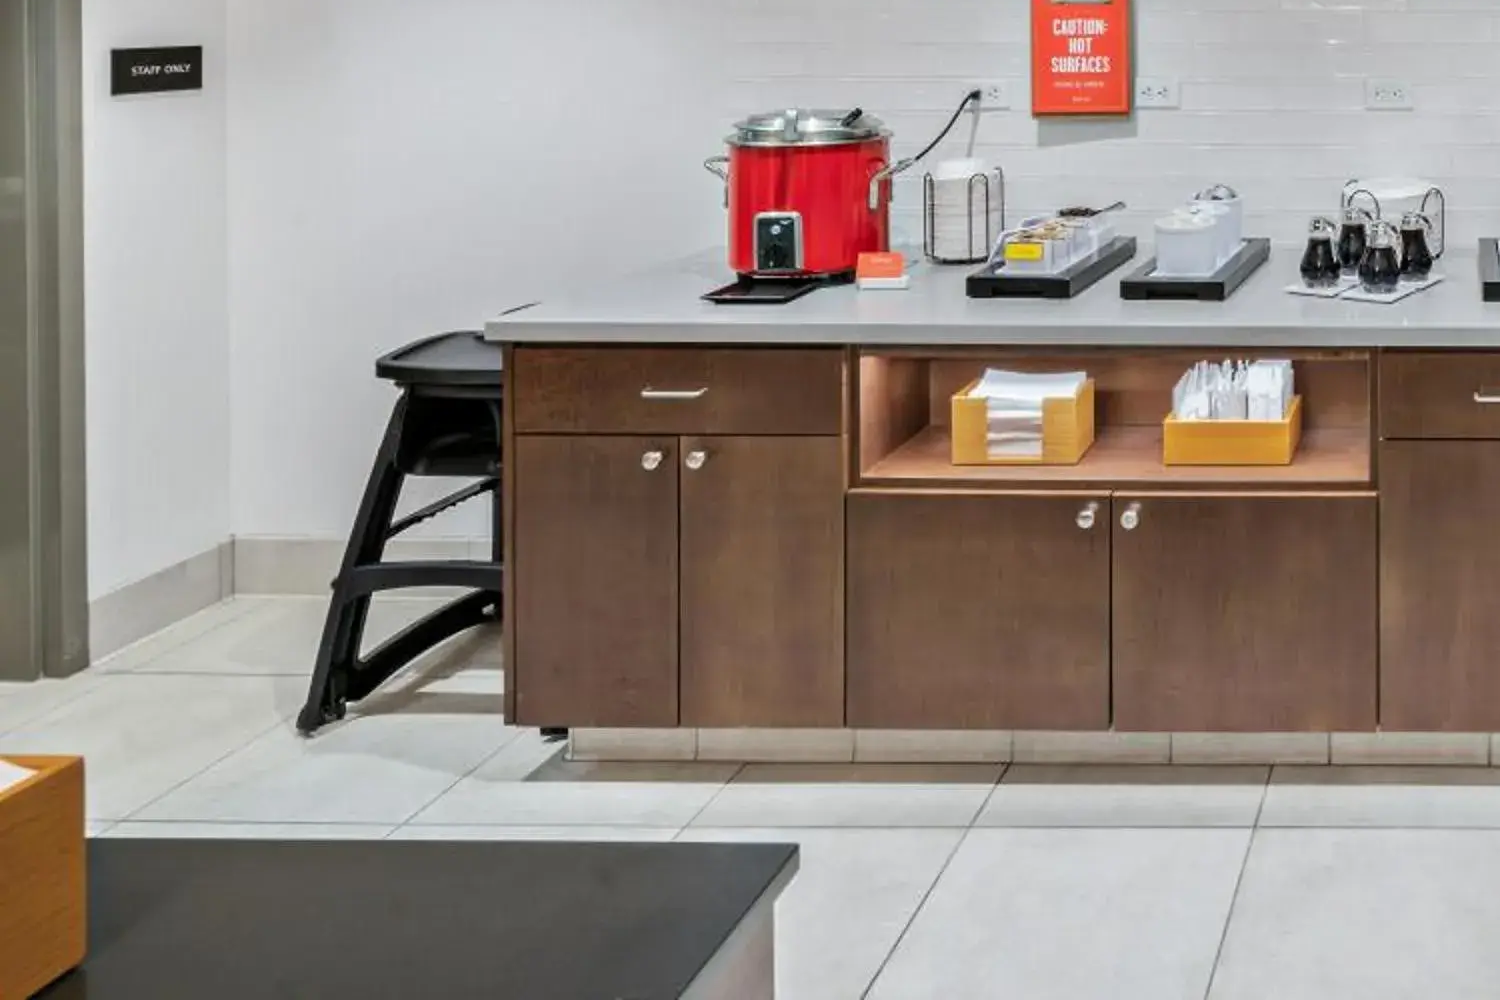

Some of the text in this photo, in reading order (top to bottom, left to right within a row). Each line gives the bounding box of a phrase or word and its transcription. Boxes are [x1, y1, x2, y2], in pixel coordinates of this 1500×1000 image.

[1068, 38, 1092, 53] HOT
[164, 64, 190, 74] ONLY
[1051, 56, 1111, 72] SURFACES
